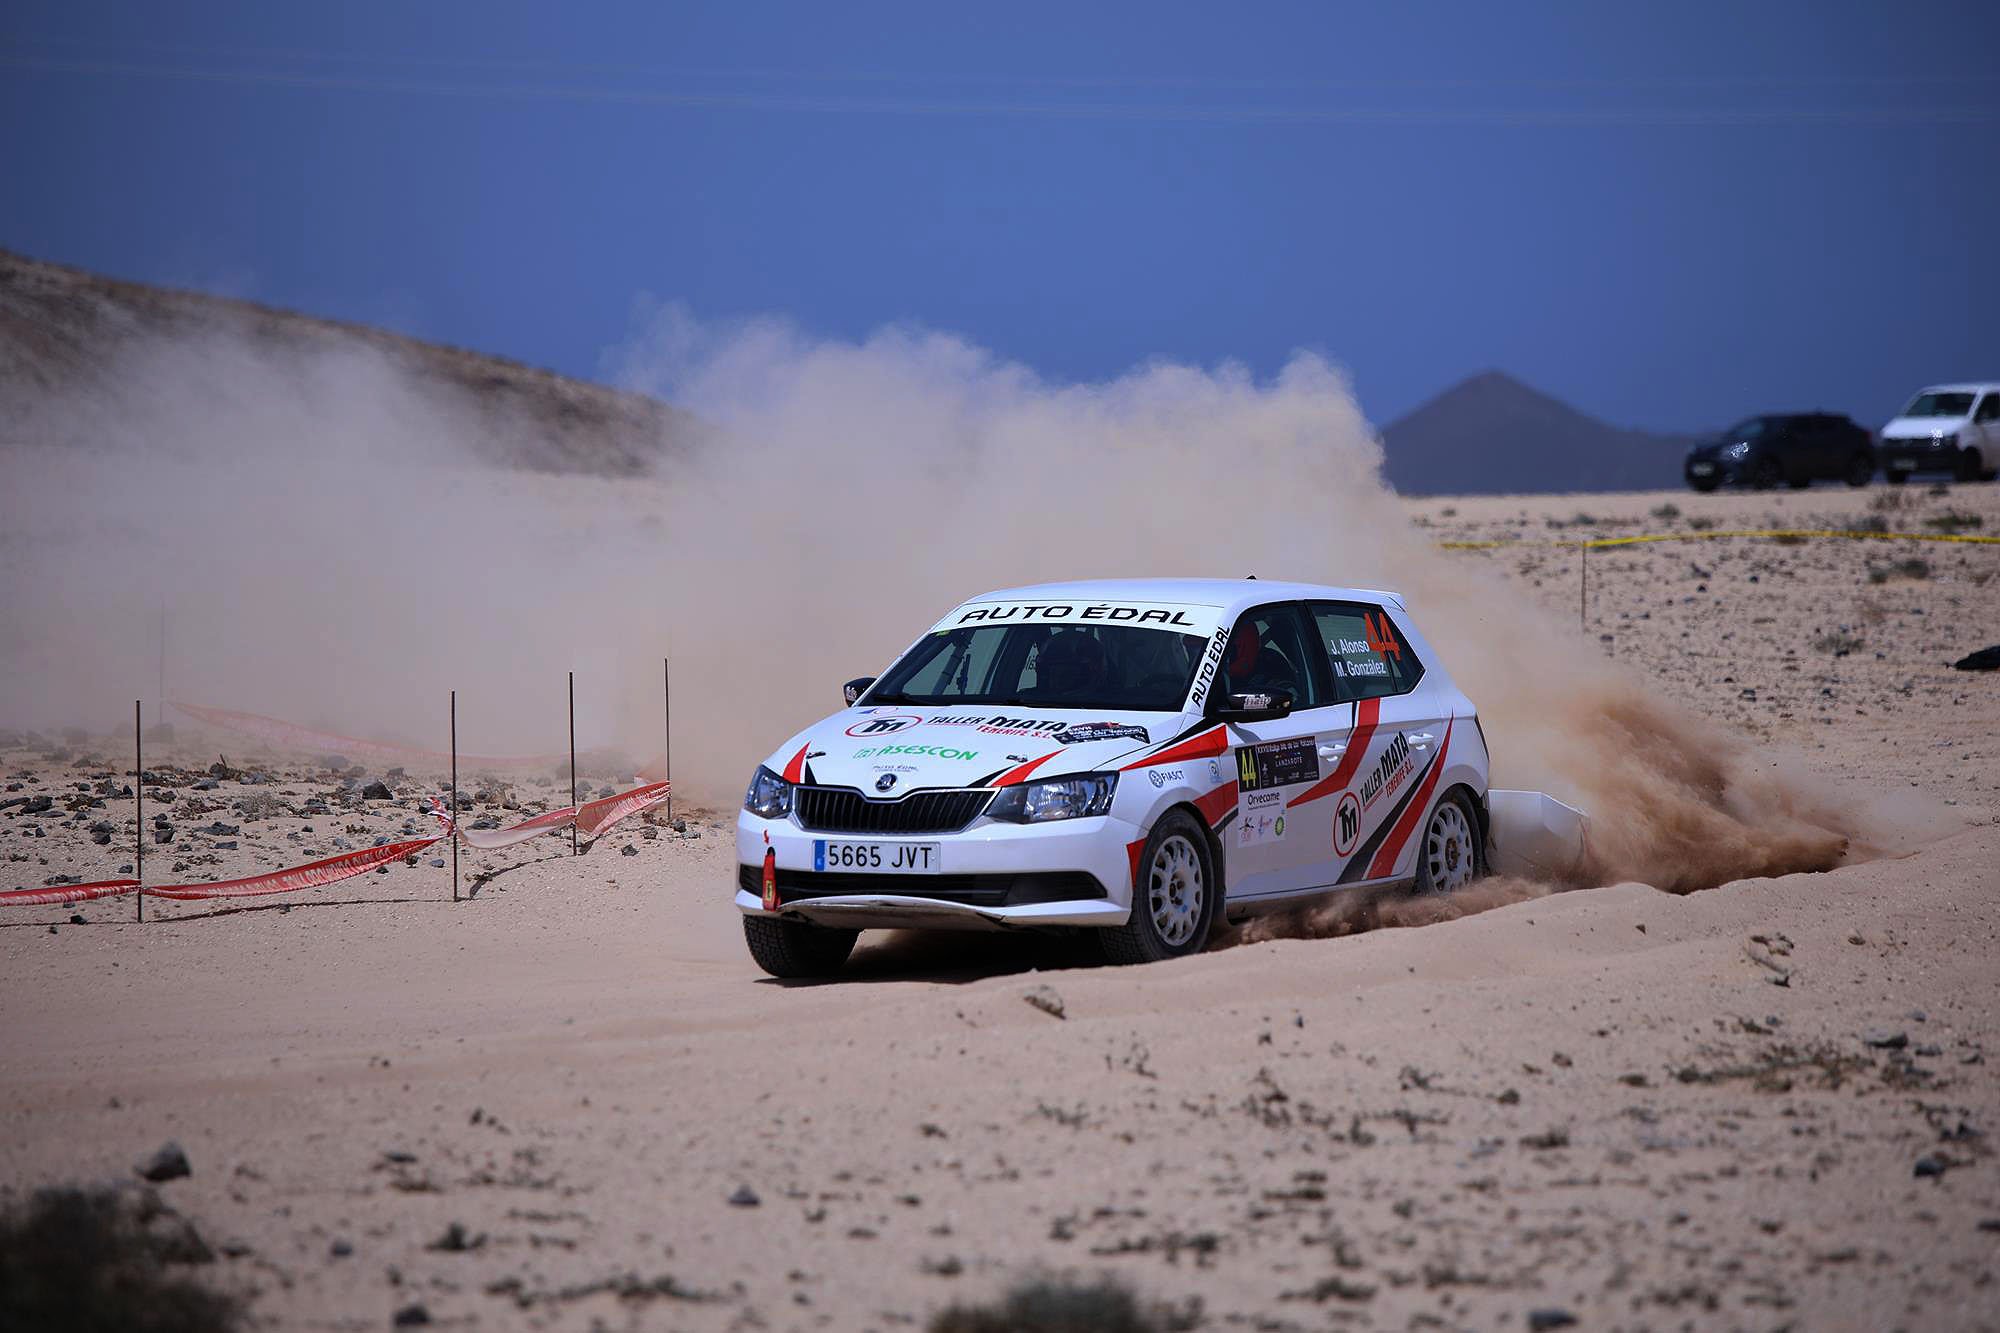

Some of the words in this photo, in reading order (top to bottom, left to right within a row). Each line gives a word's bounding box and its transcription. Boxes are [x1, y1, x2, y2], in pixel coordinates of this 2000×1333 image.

[957, 605, 1073, 624] AUTO
[1080, 603, 1195, 626] ÉDAL
[1330, 639, 1341, 655] J.
[1340, 638, 1370, 654] Alonso
[1363, 612, 1402, 662] 44
[1334, 661, 1348, 677] M.
[1346, 659, 1387, 677] González
[1191, 662, 1215, 708] AUTO
[926, 716, 986, 725] TALLER
[986, 715, 1067, 732] MATA
[976, 724, 1029, 736] TENERIFE
[876, 744, 979, 760] ASESCON
[1241, 747, 1257, 789] 44
[1360, 767, 1383, 807] TALLER
[1380, 730, 1410, 780] MATA
[1384, 767, 1406, 799] TENERIFE
[828, 845, 882, 868] 5665
[891, 846, 932, 869] JVT
